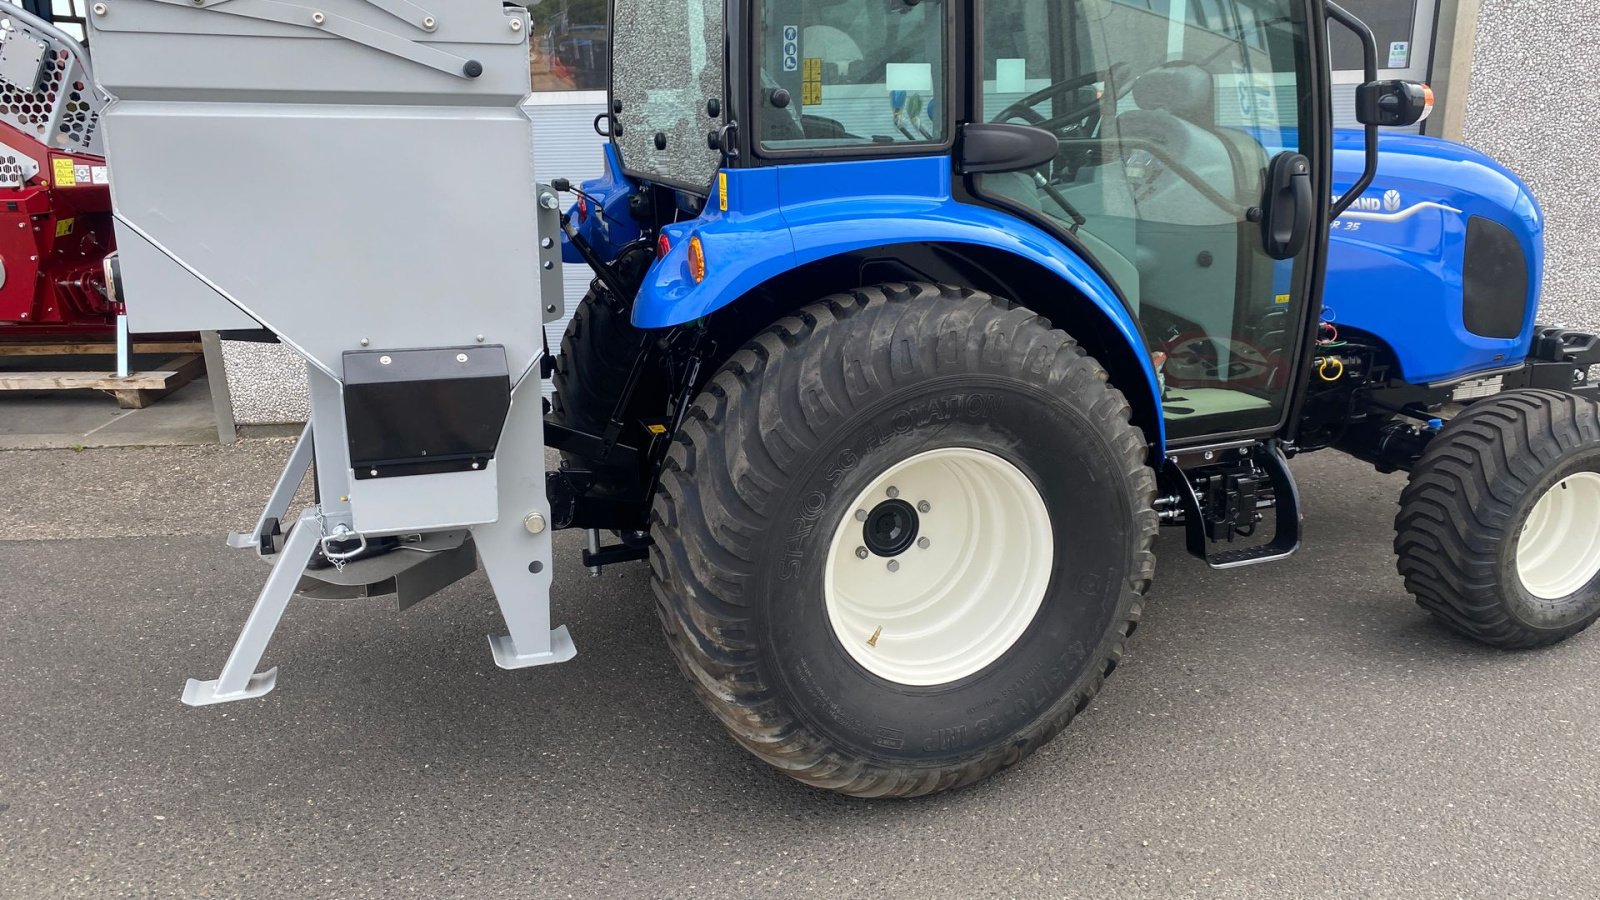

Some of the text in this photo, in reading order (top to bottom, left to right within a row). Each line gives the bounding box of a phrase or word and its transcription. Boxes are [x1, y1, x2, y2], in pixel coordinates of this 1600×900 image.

[1344, 222, 1361, 231] 35
[824, 448, 858, 487] SG
[863, 393, 1007, 453] FLOTATION
